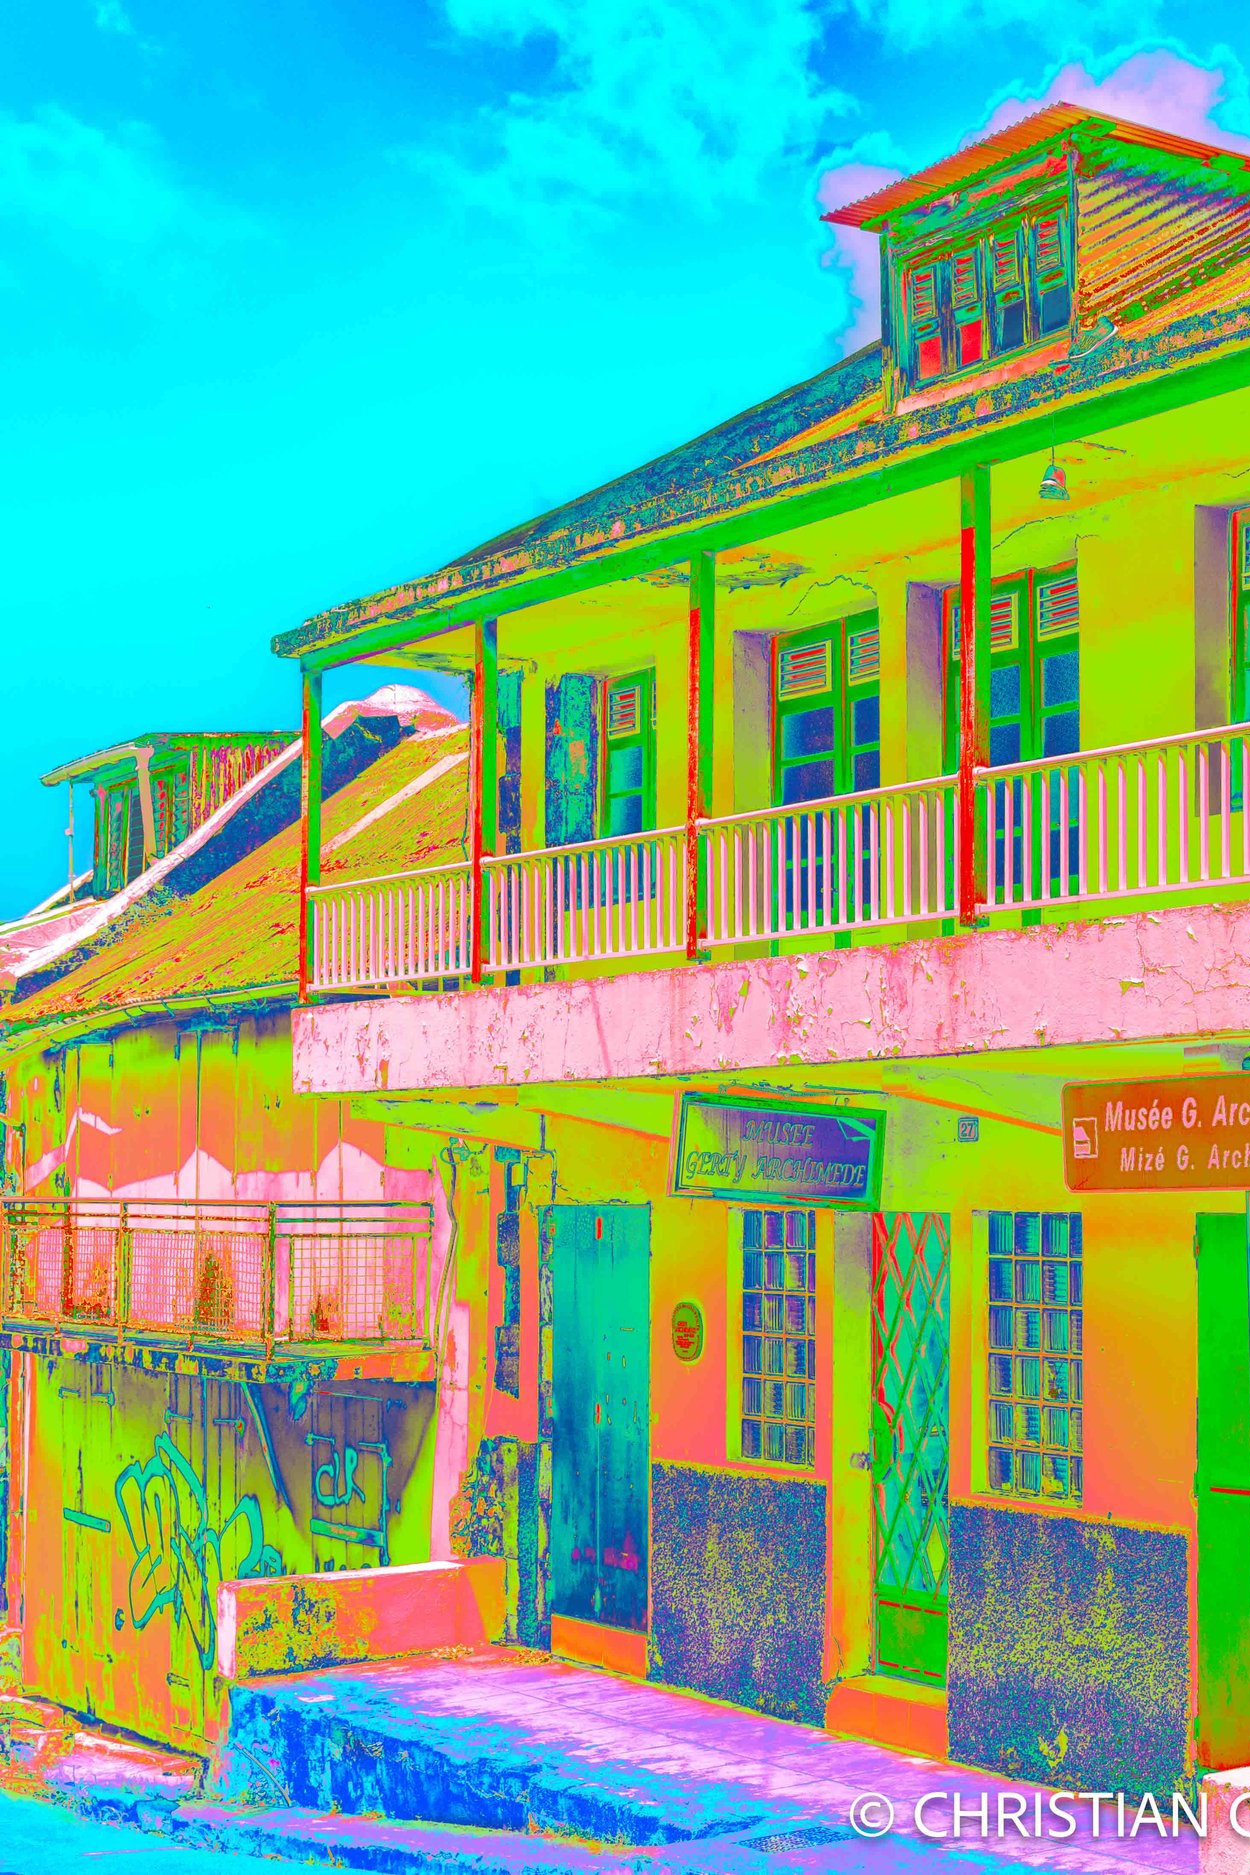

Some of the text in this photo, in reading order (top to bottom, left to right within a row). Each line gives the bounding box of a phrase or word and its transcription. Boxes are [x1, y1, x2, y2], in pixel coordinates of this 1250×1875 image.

[1104, 1099, 1173, 1132] Musée
[1181, 1096, 1202, 1128] G.
[741, 1119, 816, 1148] MUSEE
[961, 1122, 974, 1137] 27
[685, 1150, 867, 1187] GERTY ARCHIMEDE
[1120, 1146, 1165, 1172] Mizé
[1176, 1144, 1195, 1171] G.
